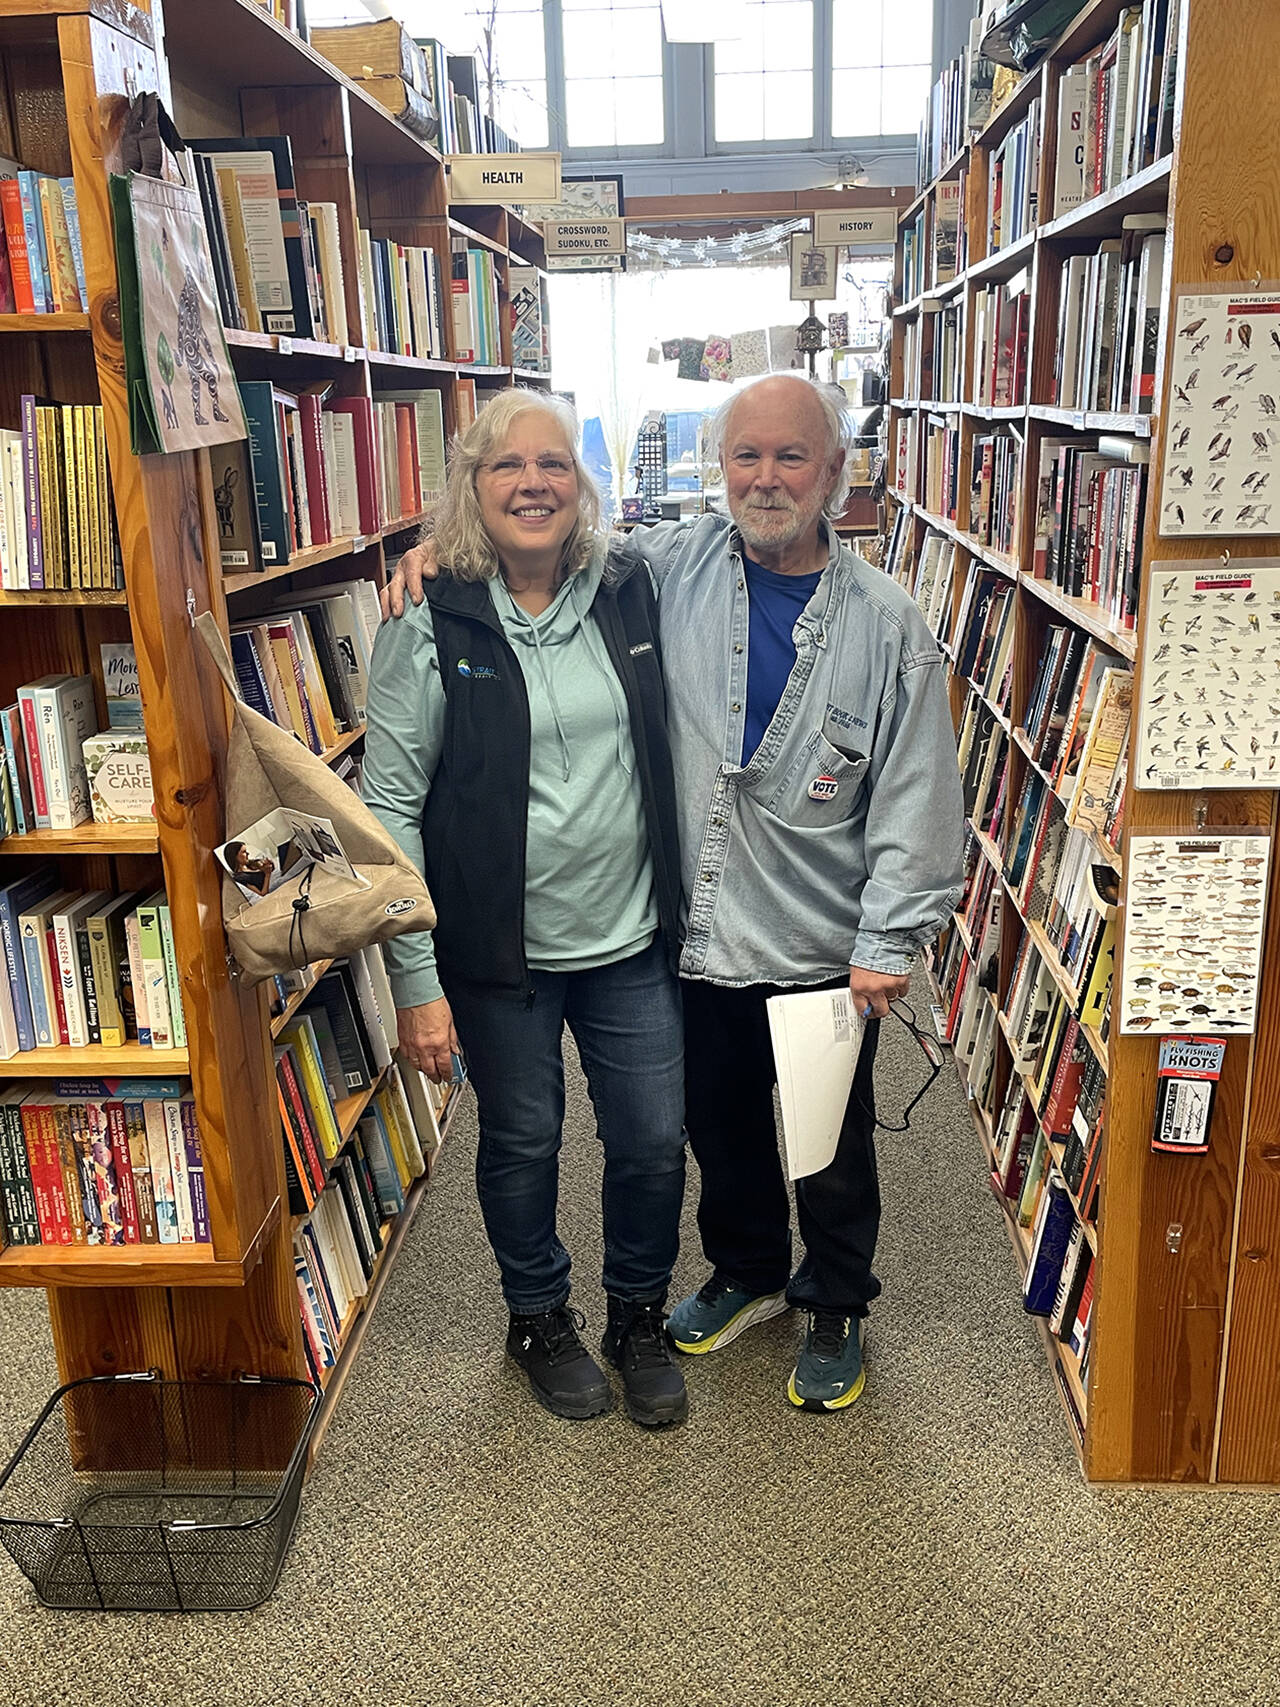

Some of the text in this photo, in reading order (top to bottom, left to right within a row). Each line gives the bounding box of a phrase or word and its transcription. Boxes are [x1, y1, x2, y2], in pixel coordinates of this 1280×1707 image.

[482, 172, 523, 184] HEALTH
[557, 226, 610, 236] CROSSWORD,
[839, 221, 874, 231] HISTORY
[557, 239, 611, 248] SUDOKU, ETC.
[24, 401, 32, 432] EVERYTHING
[108, 657, 138, 676] More
[106, 763, 149, 776] SELF-
[108, 776, 151, 789] CARE
[812, 781, 837, 794] VOTE
[1, 919, 18, 981] NORDIC LIFESTYLE
[57, 927, 69, 964] NIKSEN
[1170, 1047, 1219, 1058] FLY FISHING
[1168, 1055, 1217, 1069] KNOTS
[10, 1110, 21, 1131] Chicken
[109, 1109, 117, 1133] Woman's
[115, 1109, 124, 1130] Chicken
[168, 1105, 179, 1128] Chicken
[14, 1132, 23, 1144] Soup
[117, 1131, 126, 1145] Soup
[169, 1127, 179, 1141] Soup
[173, 1151, 182, 1170] Teenage
[21, 1166, 29, 1178] Soul
